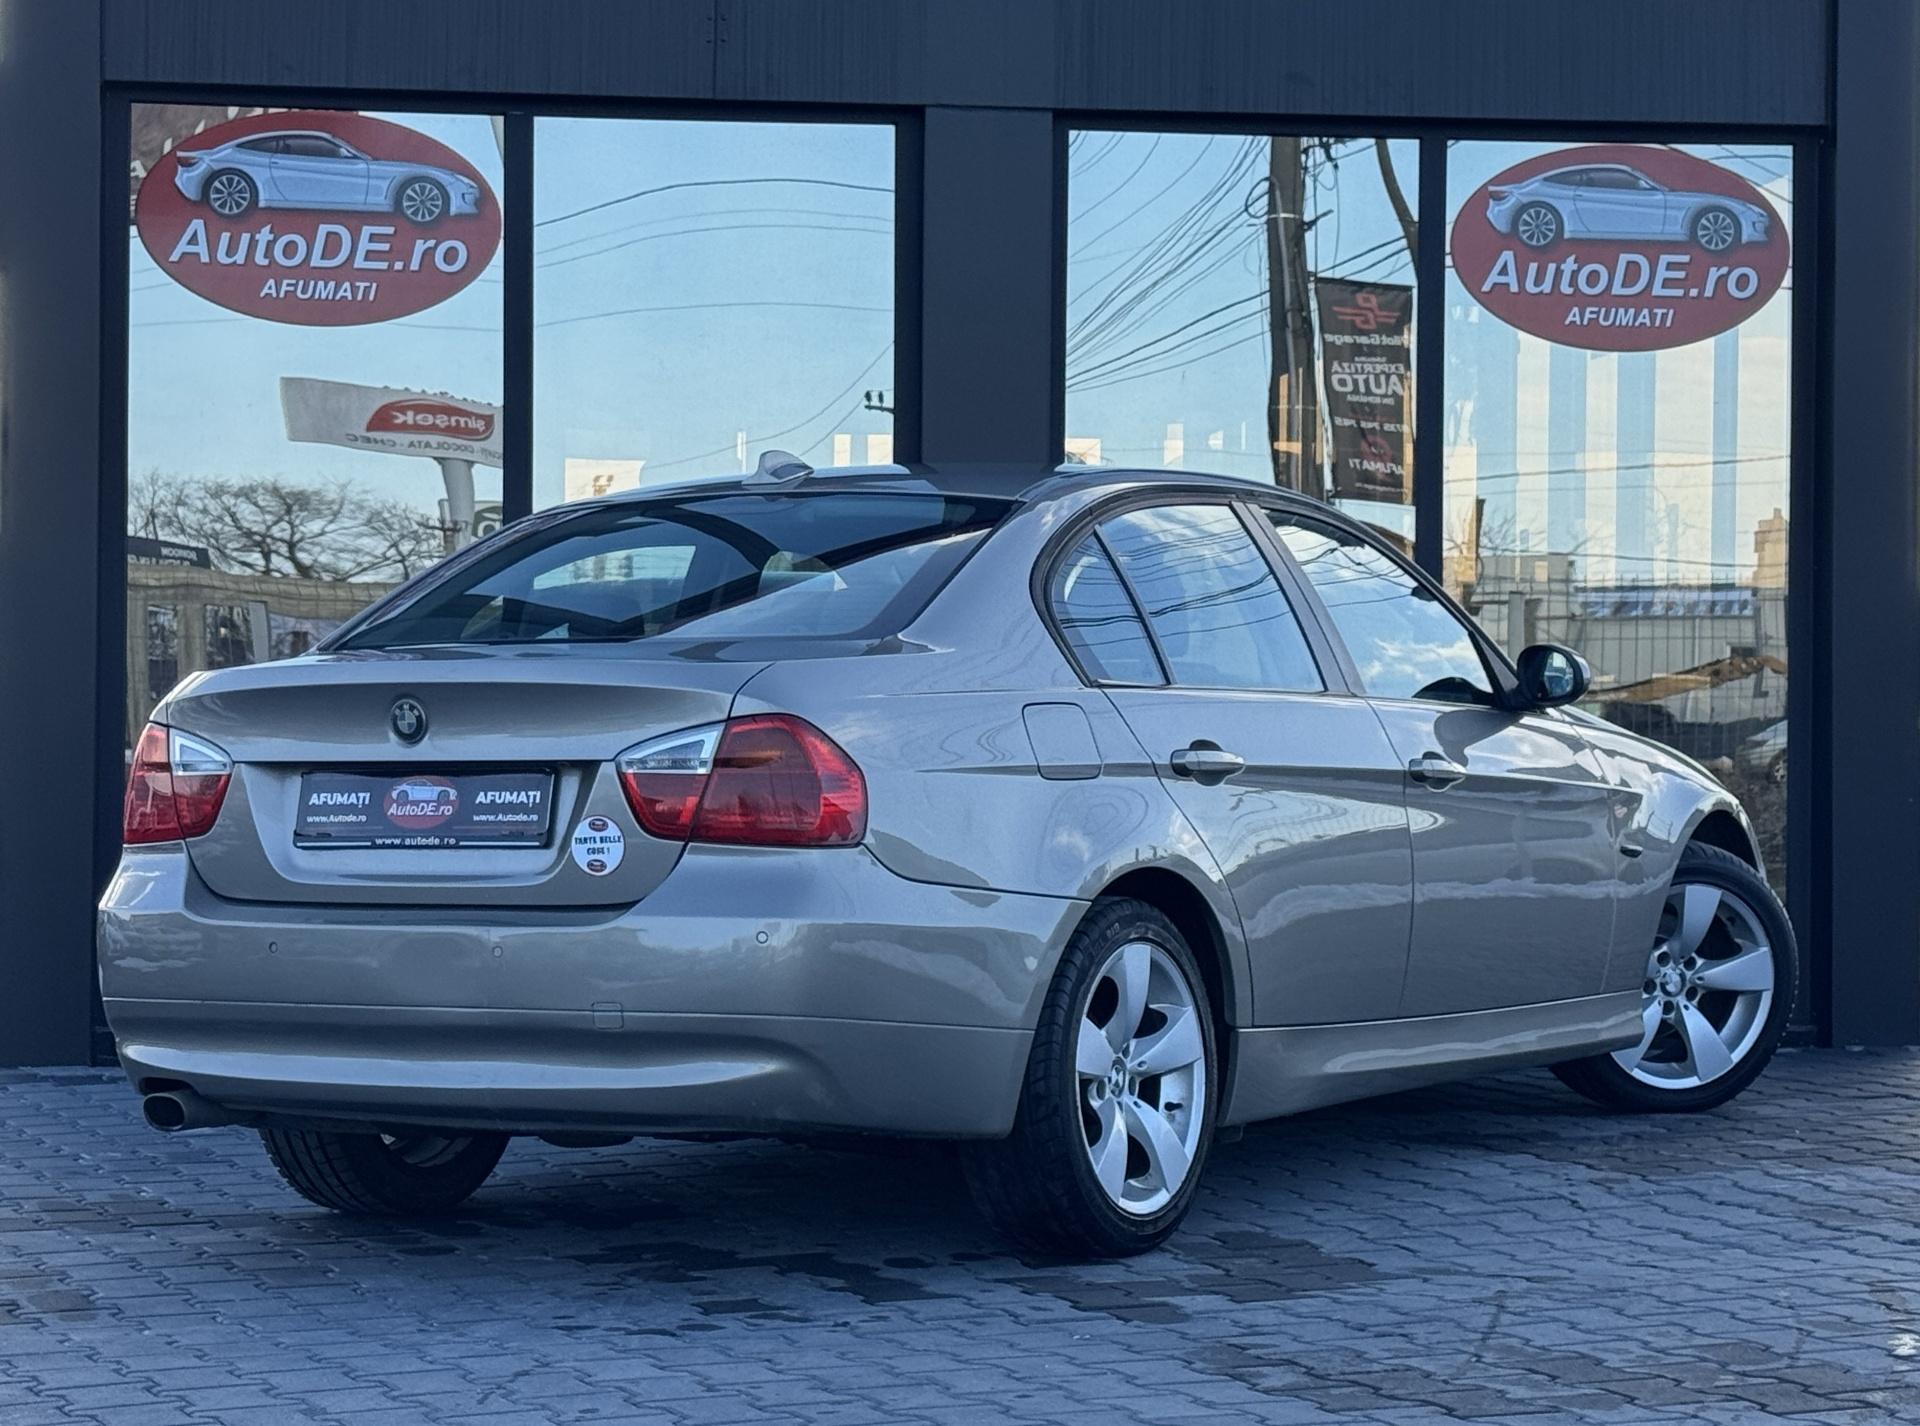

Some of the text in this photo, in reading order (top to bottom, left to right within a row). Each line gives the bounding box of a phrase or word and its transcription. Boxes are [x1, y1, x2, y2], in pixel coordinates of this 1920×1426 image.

[168, 217, 469, 273] AutoDE.ro
[1481, 249, 1759, 300] AutoDE.ro
[260, 278, 377, 302] AFUMATI
[1564, 306, 1674, 328] AFUMATI
[387, 802, 453, 817] AutoDE.ro
[375, 836, 457, 846] www.autode.ro
